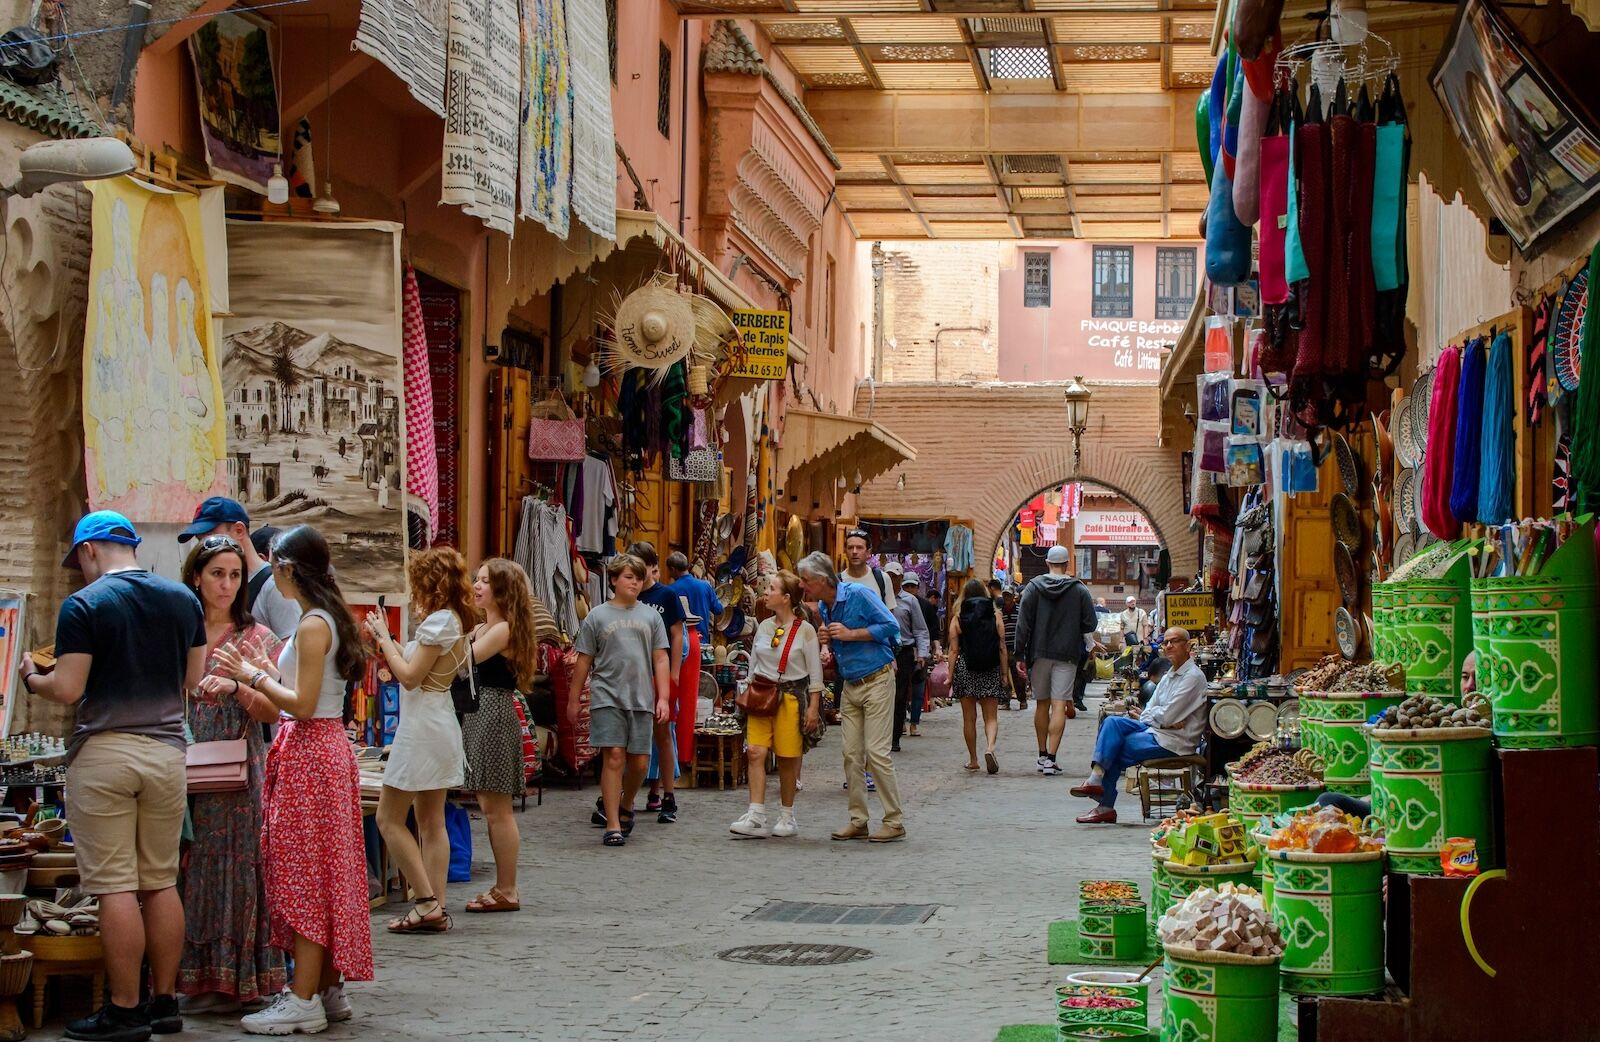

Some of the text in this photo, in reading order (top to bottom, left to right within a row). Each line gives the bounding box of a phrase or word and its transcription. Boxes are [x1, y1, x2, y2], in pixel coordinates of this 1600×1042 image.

[733, 312, 785, 329] BERBERE
[1080, 320, 1137, 333] FNAQUE
[622, 323, 680, 360] Home Sweet
[743, 330, 784, 347] de Tapis
[1088, 335, 1130, 348] Café
[1114, 350, 1133, 368] Café
[749, 364, 759, 375] 42
[761, 365, 771, 376] 65
[773, 366, 783, 377] 20
[1100, 514, 1138, 523] FNAQUE
[1085, 523, 1150, 533] Café Littéraire &
[1169, 597, 1178, 608] LA
[1178, 597, 1197, 608] CROIX
[1171, 618, 1198, 626] OUVERT
